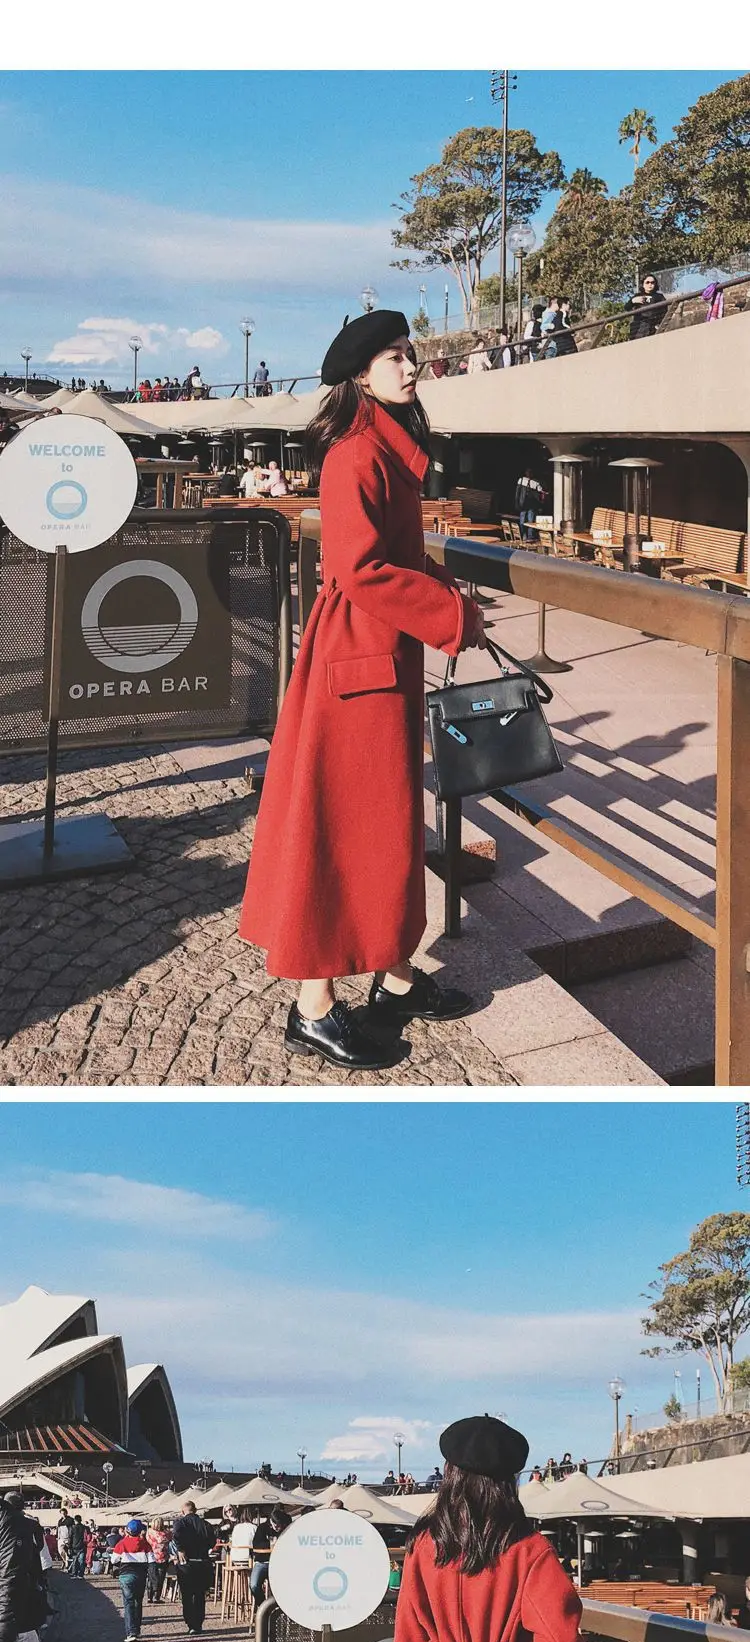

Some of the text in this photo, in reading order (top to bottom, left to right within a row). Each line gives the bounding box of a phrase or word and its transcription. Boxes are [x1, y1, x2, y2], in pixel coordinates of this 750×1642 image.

[29, 444, 106, 457] WELCOME
[61, 462, 74, 473] to
[68, 676, 208, 699] OPERA BAR
[297, 1535, 363, 1546] WELCOME
[325, 1551, 336, 1560] to
